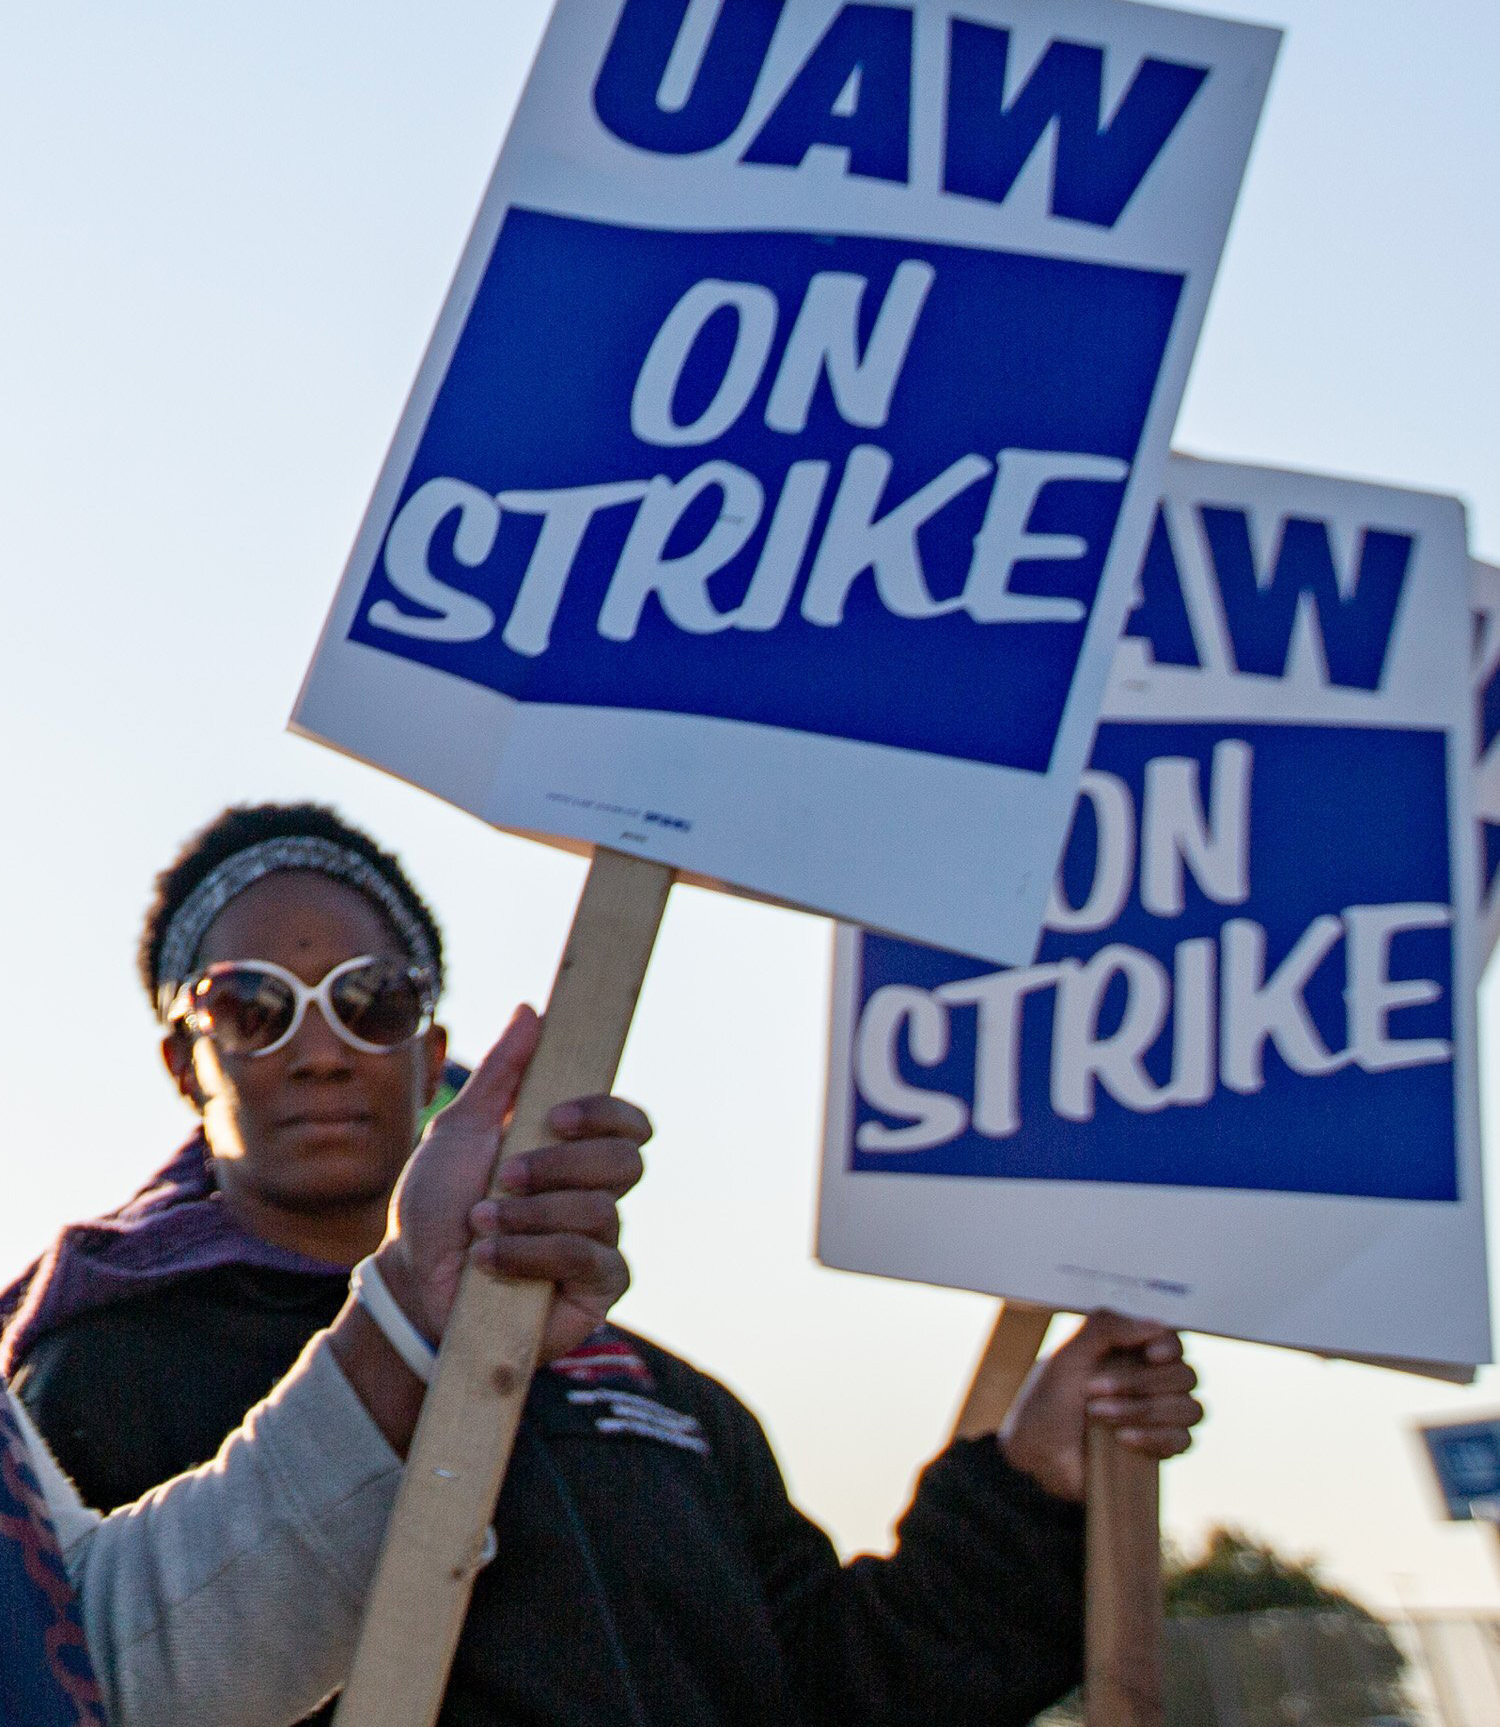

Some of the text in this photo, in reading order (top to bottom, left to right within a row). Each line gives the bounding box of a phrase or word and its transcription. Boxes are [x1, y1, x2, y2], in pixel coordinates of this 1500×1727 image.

[630, 258, 936, 448] ON
[366, 443, 1130, 658] STRIKE
[1121, 498, 1418, 695] AW
[1045, 738, 1252, 934] ON
[855, 902, 1456, 1154] STRIKE
